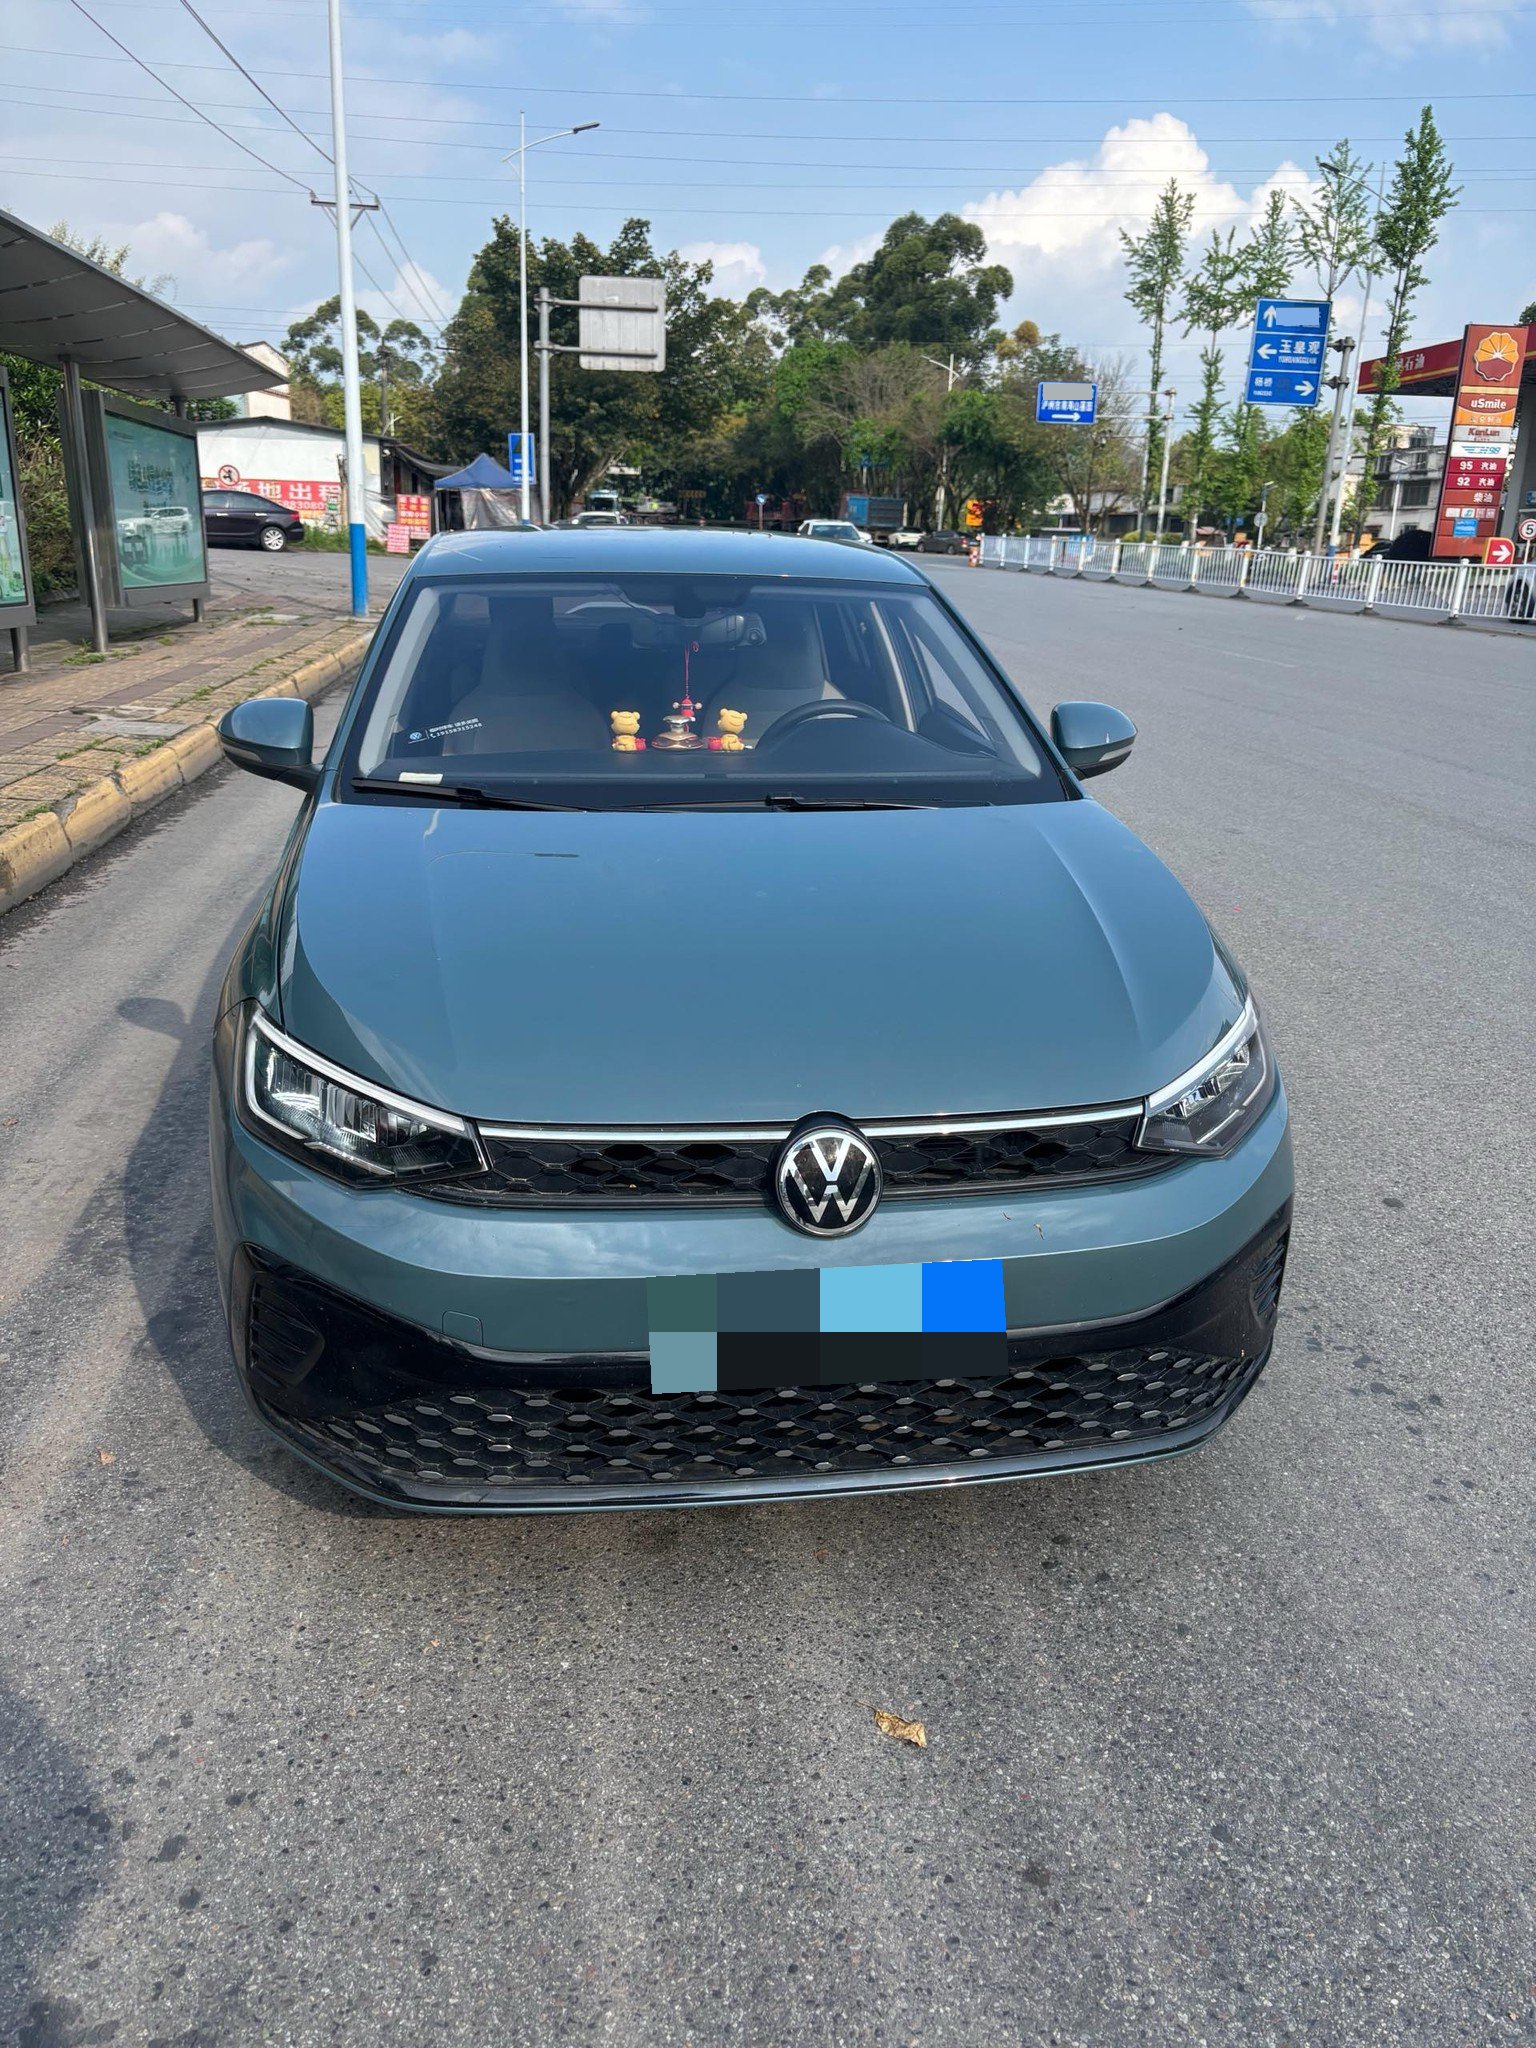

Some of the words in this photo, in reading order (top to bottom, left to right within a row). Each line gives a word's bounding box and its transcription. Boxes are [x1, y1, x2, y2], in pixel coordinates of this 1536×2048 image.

[1278, 339, 1321, 354] 玉皇观
[1470, 398, 1507, 409] uSmile
[1460, 461, 1473, 470] 95
[1481, 462, 1497, 471] 汽油
[1457, 477, 1470, 486] 92
[1478, 478, 1495, 486] 汽油
[1473, 492, 1493, 503] 柴油
[1526, 524, 1534, 535] 5
